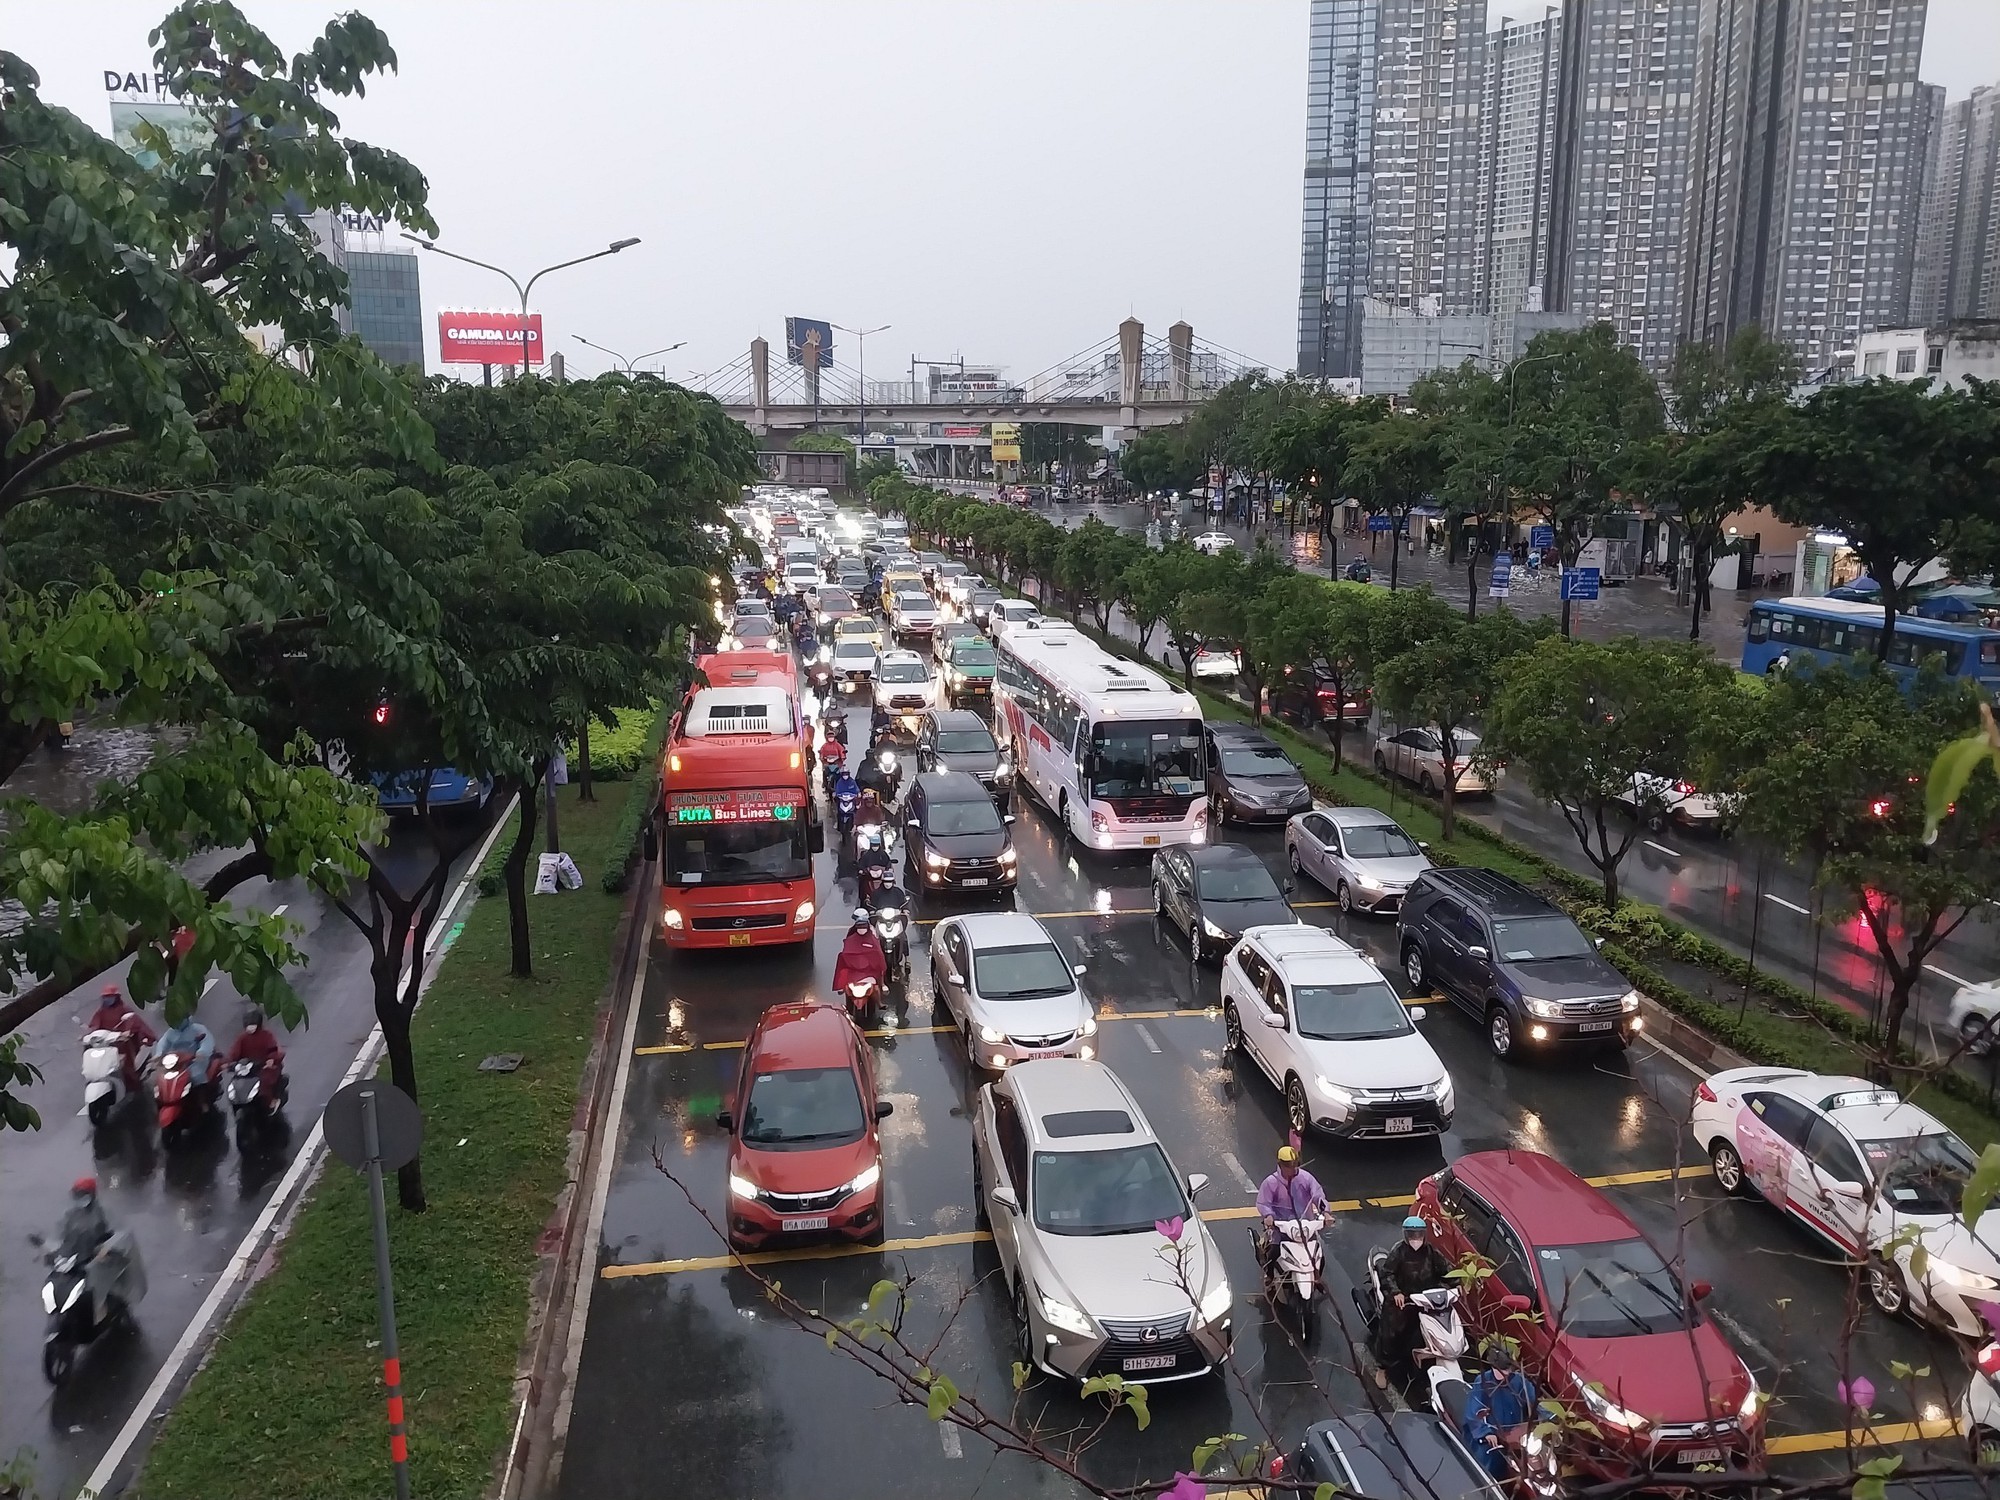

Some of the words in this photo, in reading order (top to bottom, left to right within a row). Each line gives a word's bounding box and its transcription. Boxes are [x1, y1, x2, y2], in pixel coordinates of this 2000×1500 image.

[447, 328, 503, 340] GAMUDA
[704, 794, 731, 803] TRANG
[737, 792, 763, 802] FUTA
[767, 792, 781, 801] Bus
[783, 791, 802, 801] Lines
[679, 809, 713, 821] FUTA
[715, 809, 736, 820] Bus
[740, 807, 771, 819] Lines
